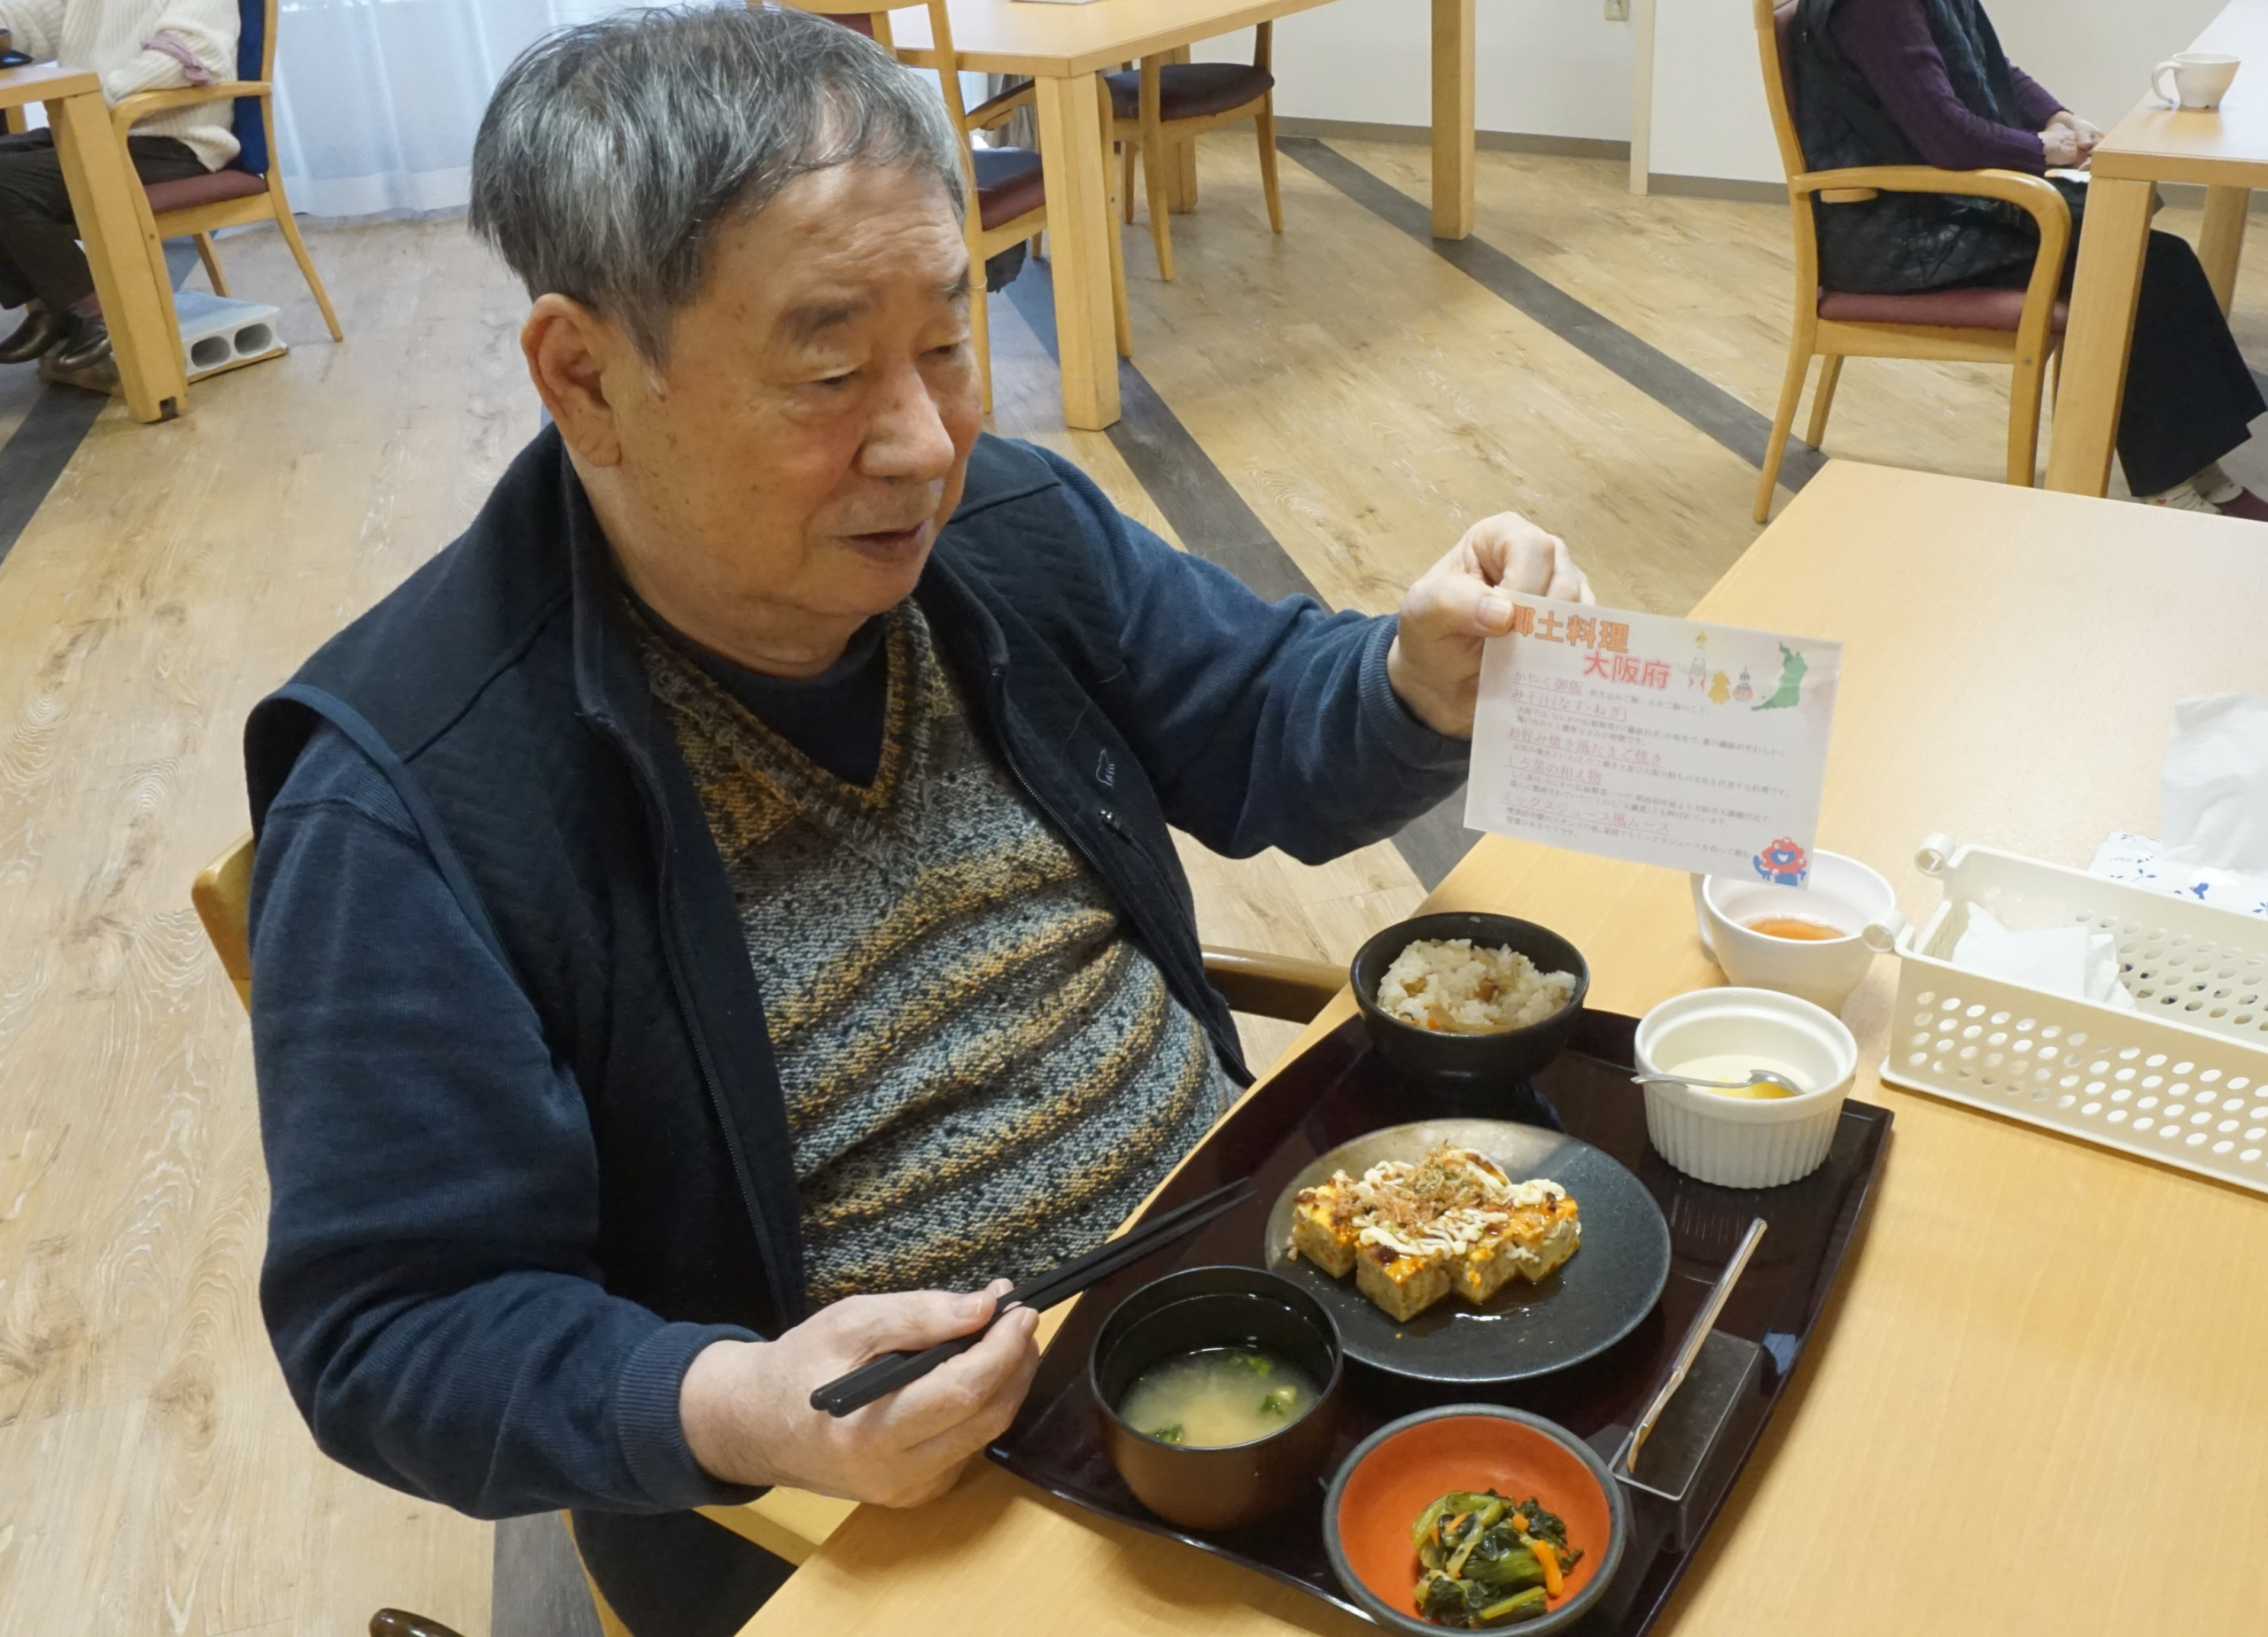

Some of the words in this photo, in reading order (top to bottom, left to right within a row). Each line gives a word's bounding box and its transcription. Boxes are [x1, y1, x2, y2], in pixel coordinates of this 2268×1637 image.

[1514, 606, 1629, 654] 郷土料理
[1582, 649, 1672, 689] 大阪府
[1508, 725, 1663, 766] お好み焼き風たまご焼き
[1507, 754, 1603, 784] しろ菜の和え物
[1502, 790, 1671, 834] ミックスジュース風ムース
